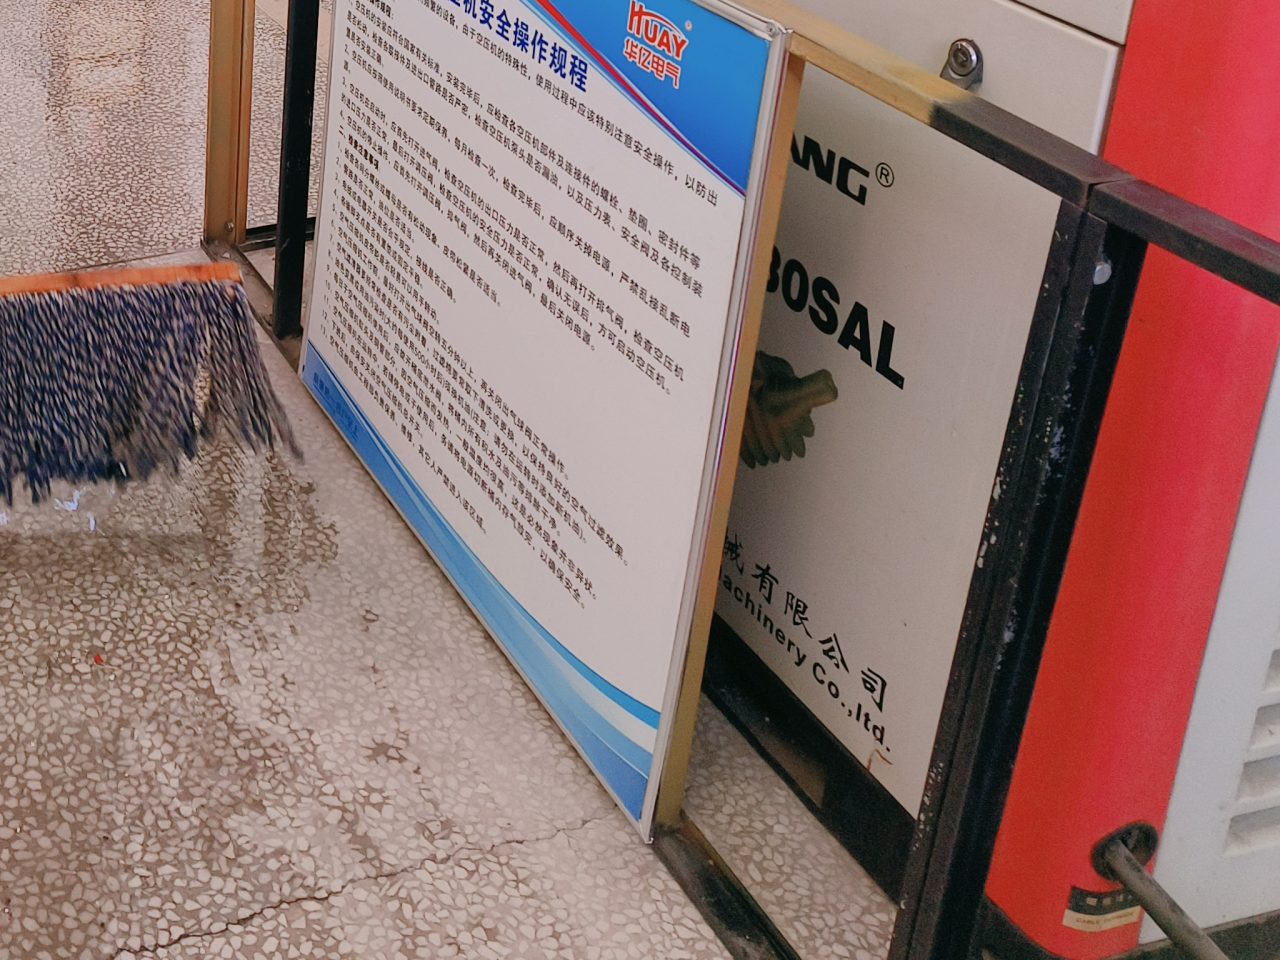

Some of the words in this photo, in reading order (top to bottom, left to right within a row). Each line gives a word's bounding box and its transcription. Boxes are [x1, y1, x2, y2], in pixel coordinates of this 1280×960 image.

[623, 37, 681, 89] 华亿电气
[719, 567, 807, 667] achinery
